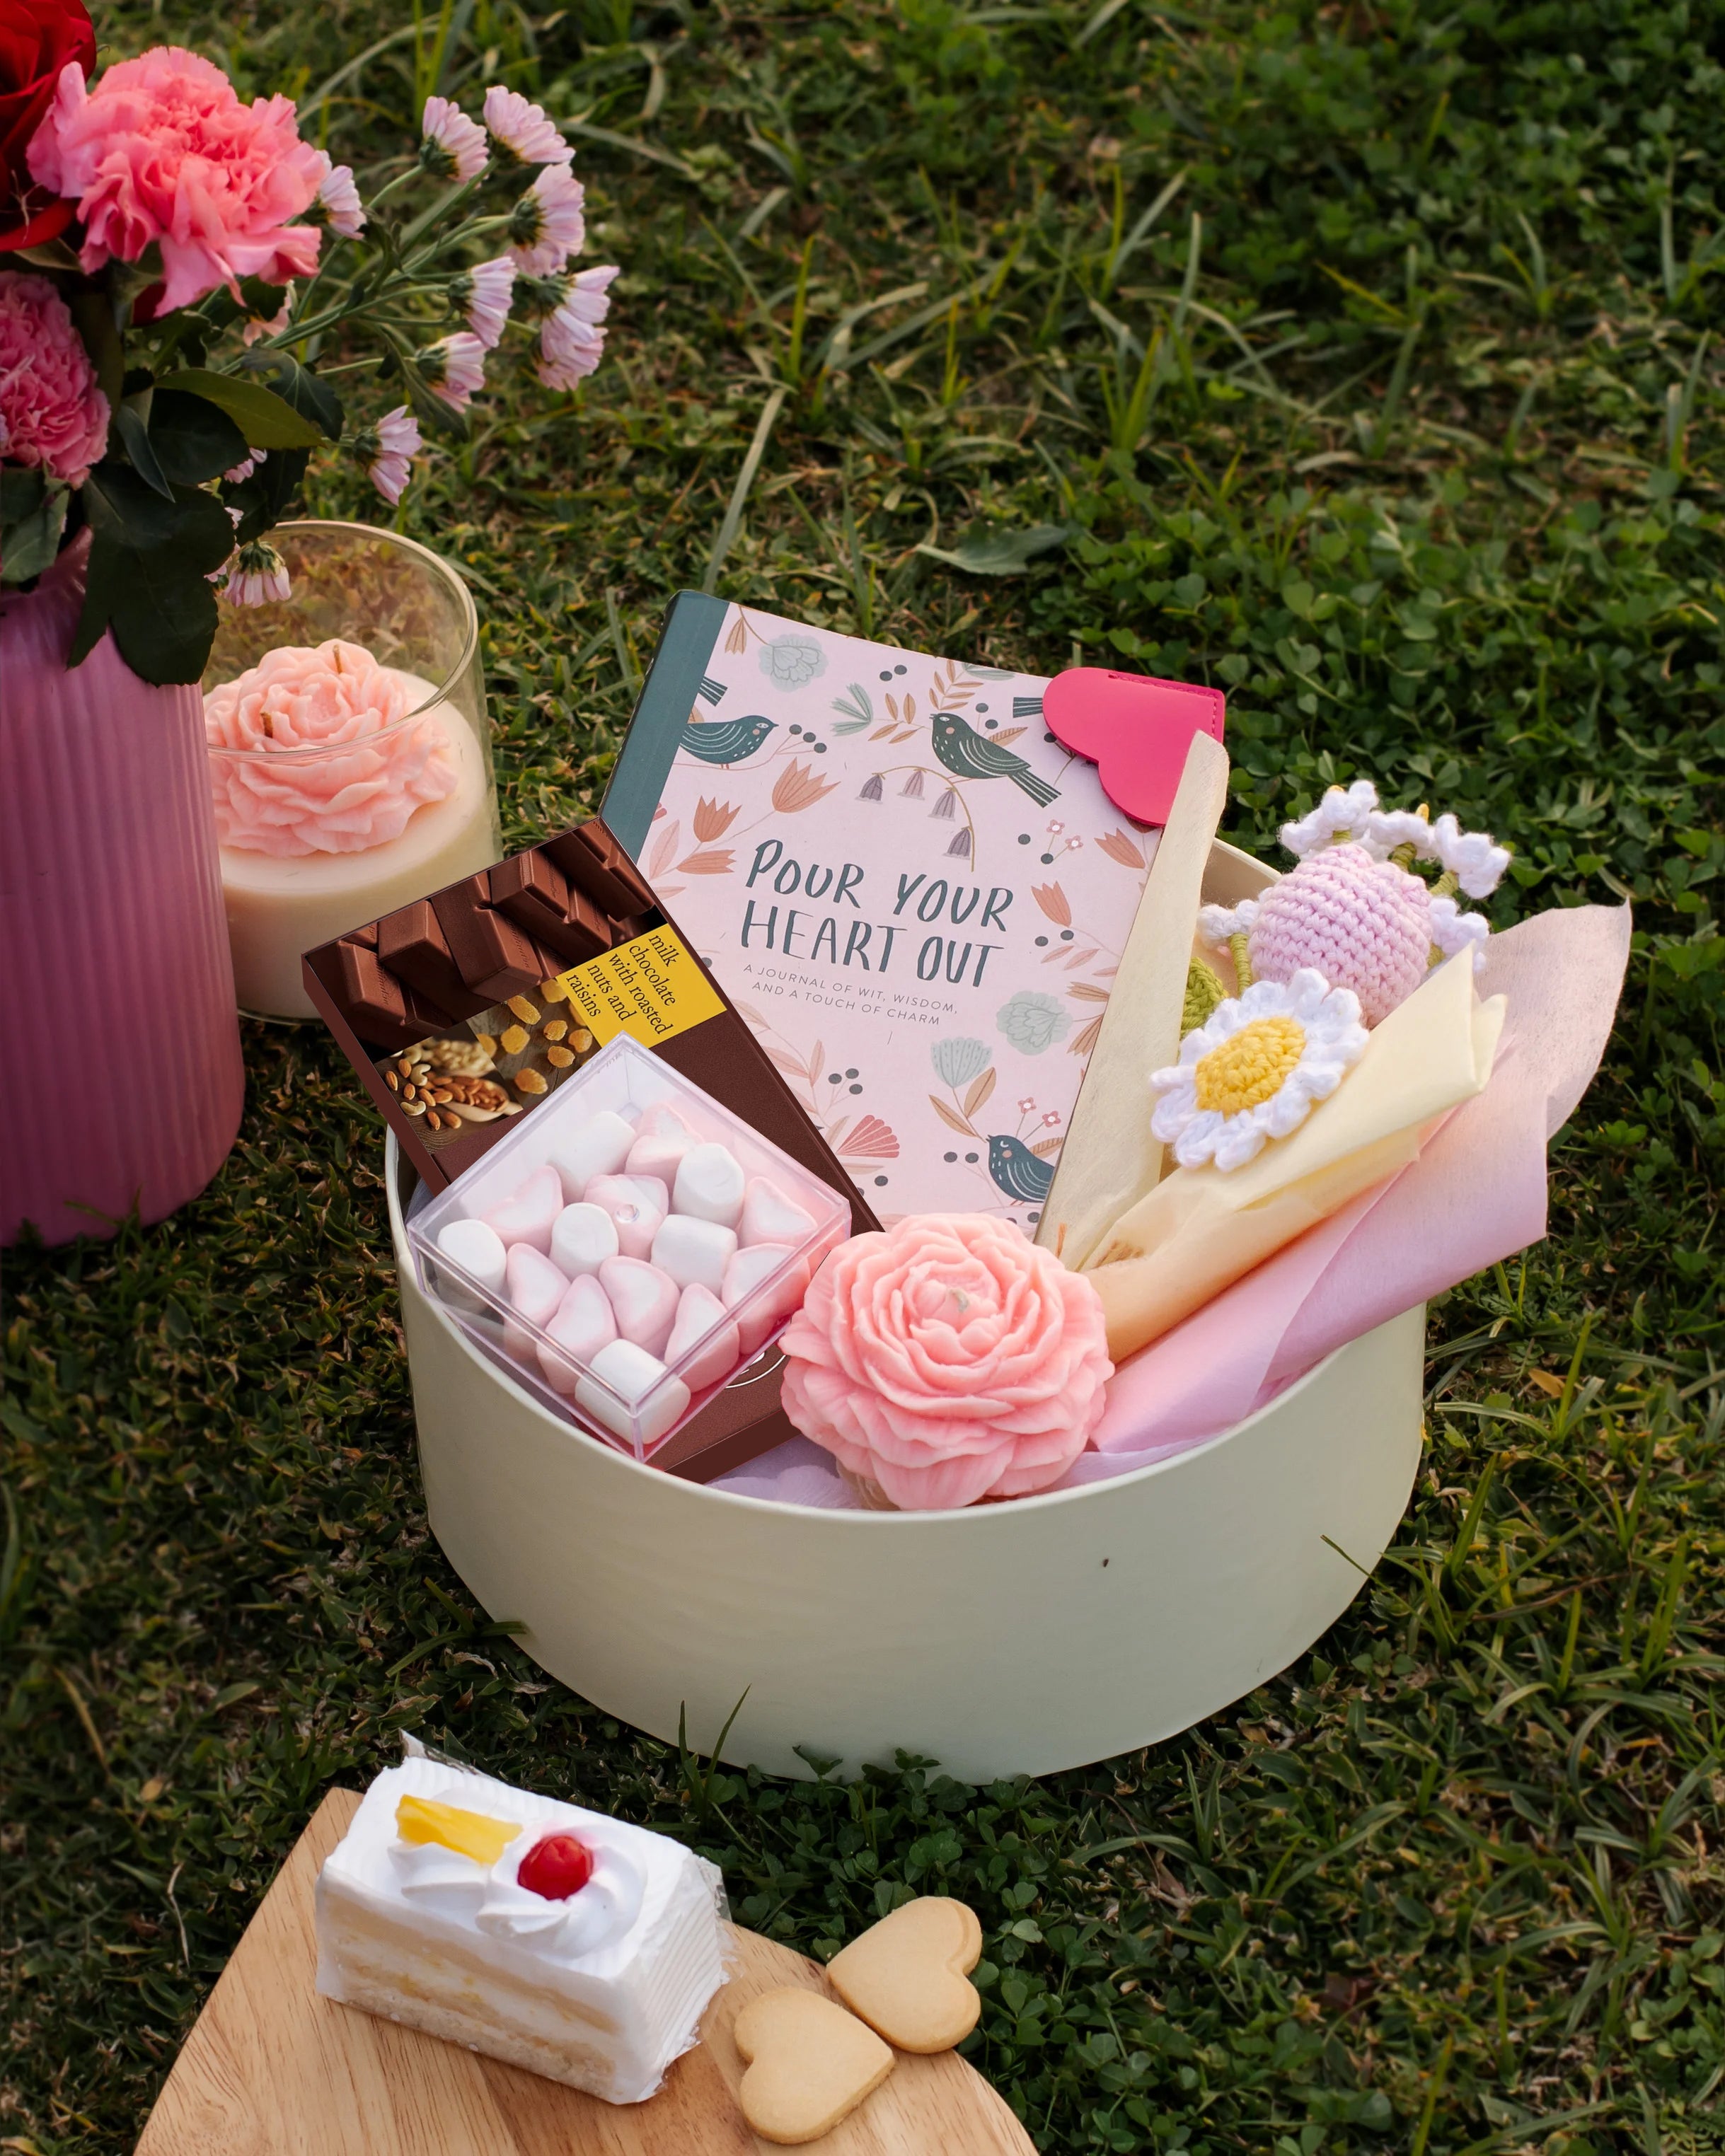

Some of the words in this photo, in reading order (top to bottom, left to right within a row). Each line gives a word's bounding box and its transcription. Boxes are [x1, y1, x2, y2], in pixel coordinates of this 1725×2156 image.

[745, 839, 864, 908] POUR
[893, 873, 1013, 932] YOUR
[648, 934, 680, 968] milk
[741, 900, 908, 973] HEART
[917, 936, 1005, 987] OUT
[565, 974, 601, 1017] raisins
[587, 964, 613, 995] nuts
[607, 995, 637, 1021] and
[608, 954, 638, 986] with
[628, 986, 674, 1035] roasted
[628, 945, 676, 1007] chocolate
[743, 964, 752, 973] A
[758, 967, 826, 989] JOURNAL
[832, 983, 853, 993] OF
[858, 987, 886, 1002] WIT,
[894, 994, 957, 1014] WISDOM,
[751, 982, 784, 995] AND
[788, 990, 798, 999] A
[804, 992, 855, 1010] TOUCH
[861, 1004, 882, 1014] OF
[887, 1009, 940, 1025] CHARM
